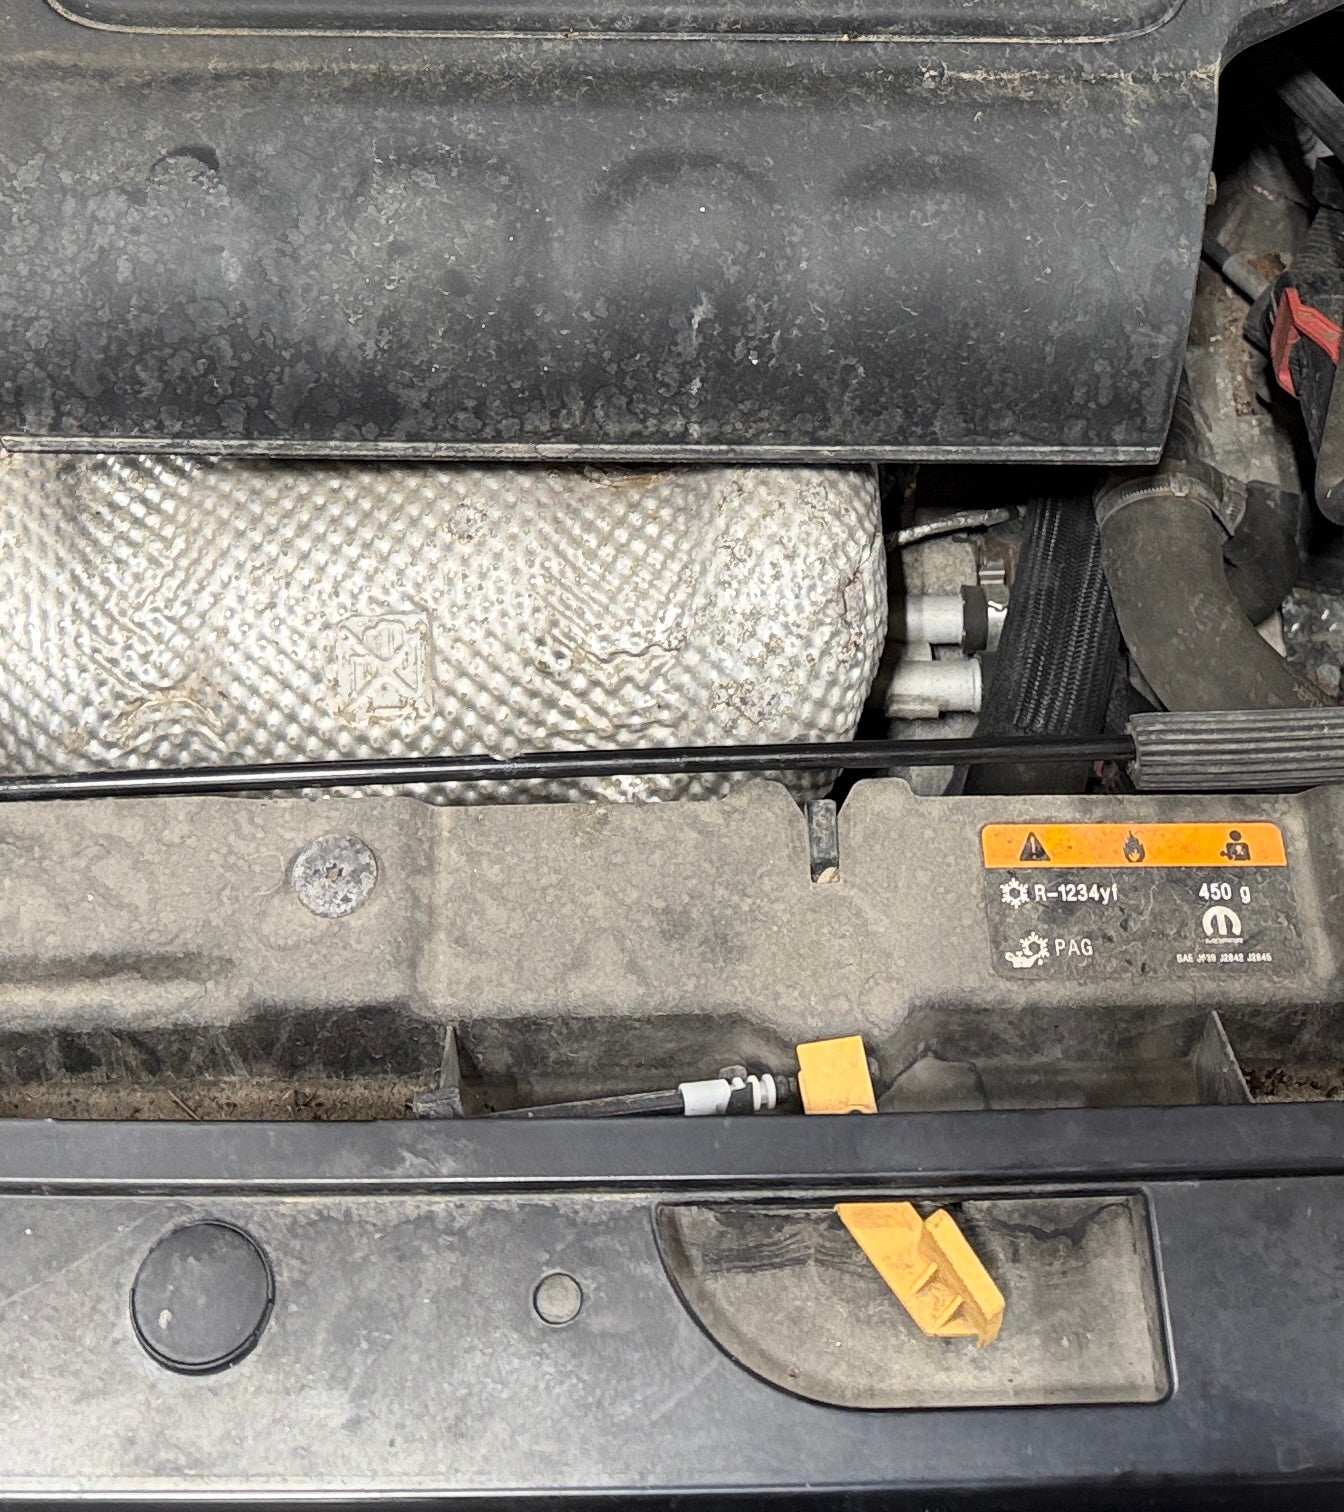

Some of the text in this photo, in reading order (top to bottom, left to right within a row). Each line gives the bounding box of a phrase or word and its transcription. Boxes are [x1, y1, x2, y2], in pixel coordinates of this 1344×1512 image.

[1033, 882, 1251, 906] R-1234yf 450 g
[1055, 937, 1094, 957] PAG
